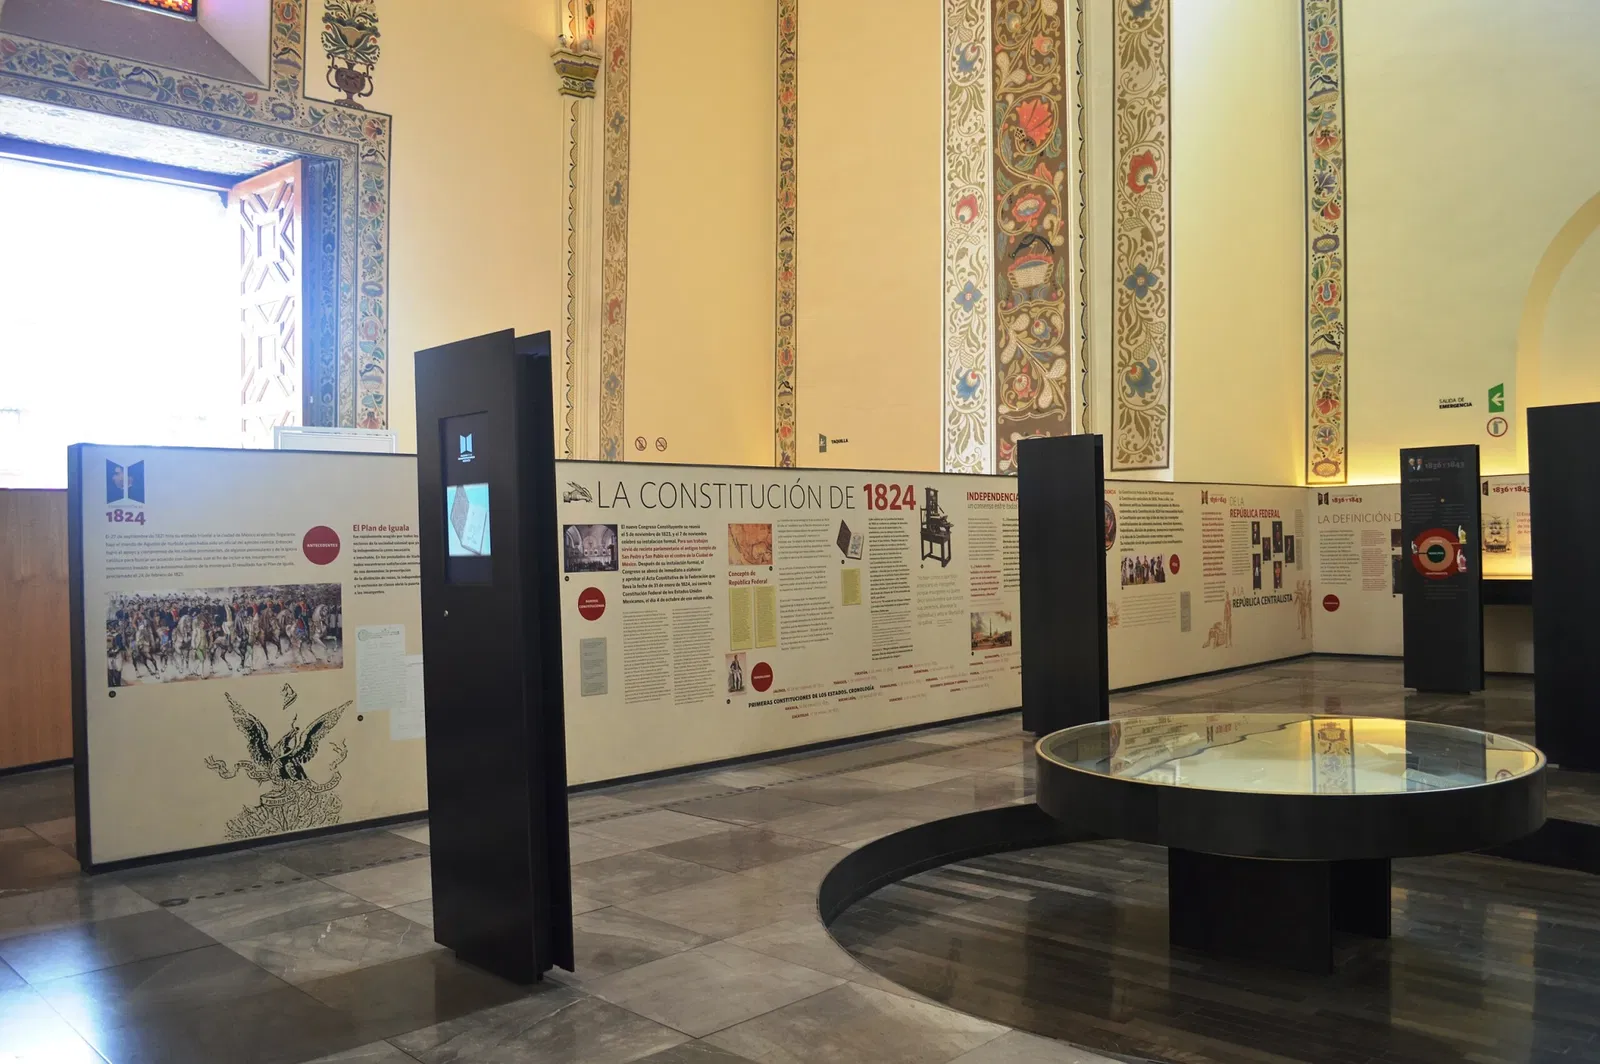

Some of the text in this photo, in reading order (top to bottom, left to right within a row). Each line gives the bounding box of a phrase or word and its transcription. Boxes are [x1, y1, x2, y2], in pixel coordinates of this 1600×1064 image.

[598, 478, 916, 511] LA CONSTITUCIÓN DE 1824
[106, 509, 146, 526] 1824
[1230, 507, 1280, 518] REPÚBLICA FEDERAL
[1318, 514, 1330, 524] LA
[1333, 510, 1391, 524] DEFINICIÓN
[1232, 593, 1293, 608] REPÚBLICA CENTRALISTA
[748, 700, 773, 708] PRIMERAS
[774, 694, 811, 704] CONSTITUCIONES
[849, 684, 874, 693] CRONOLOGÍA
